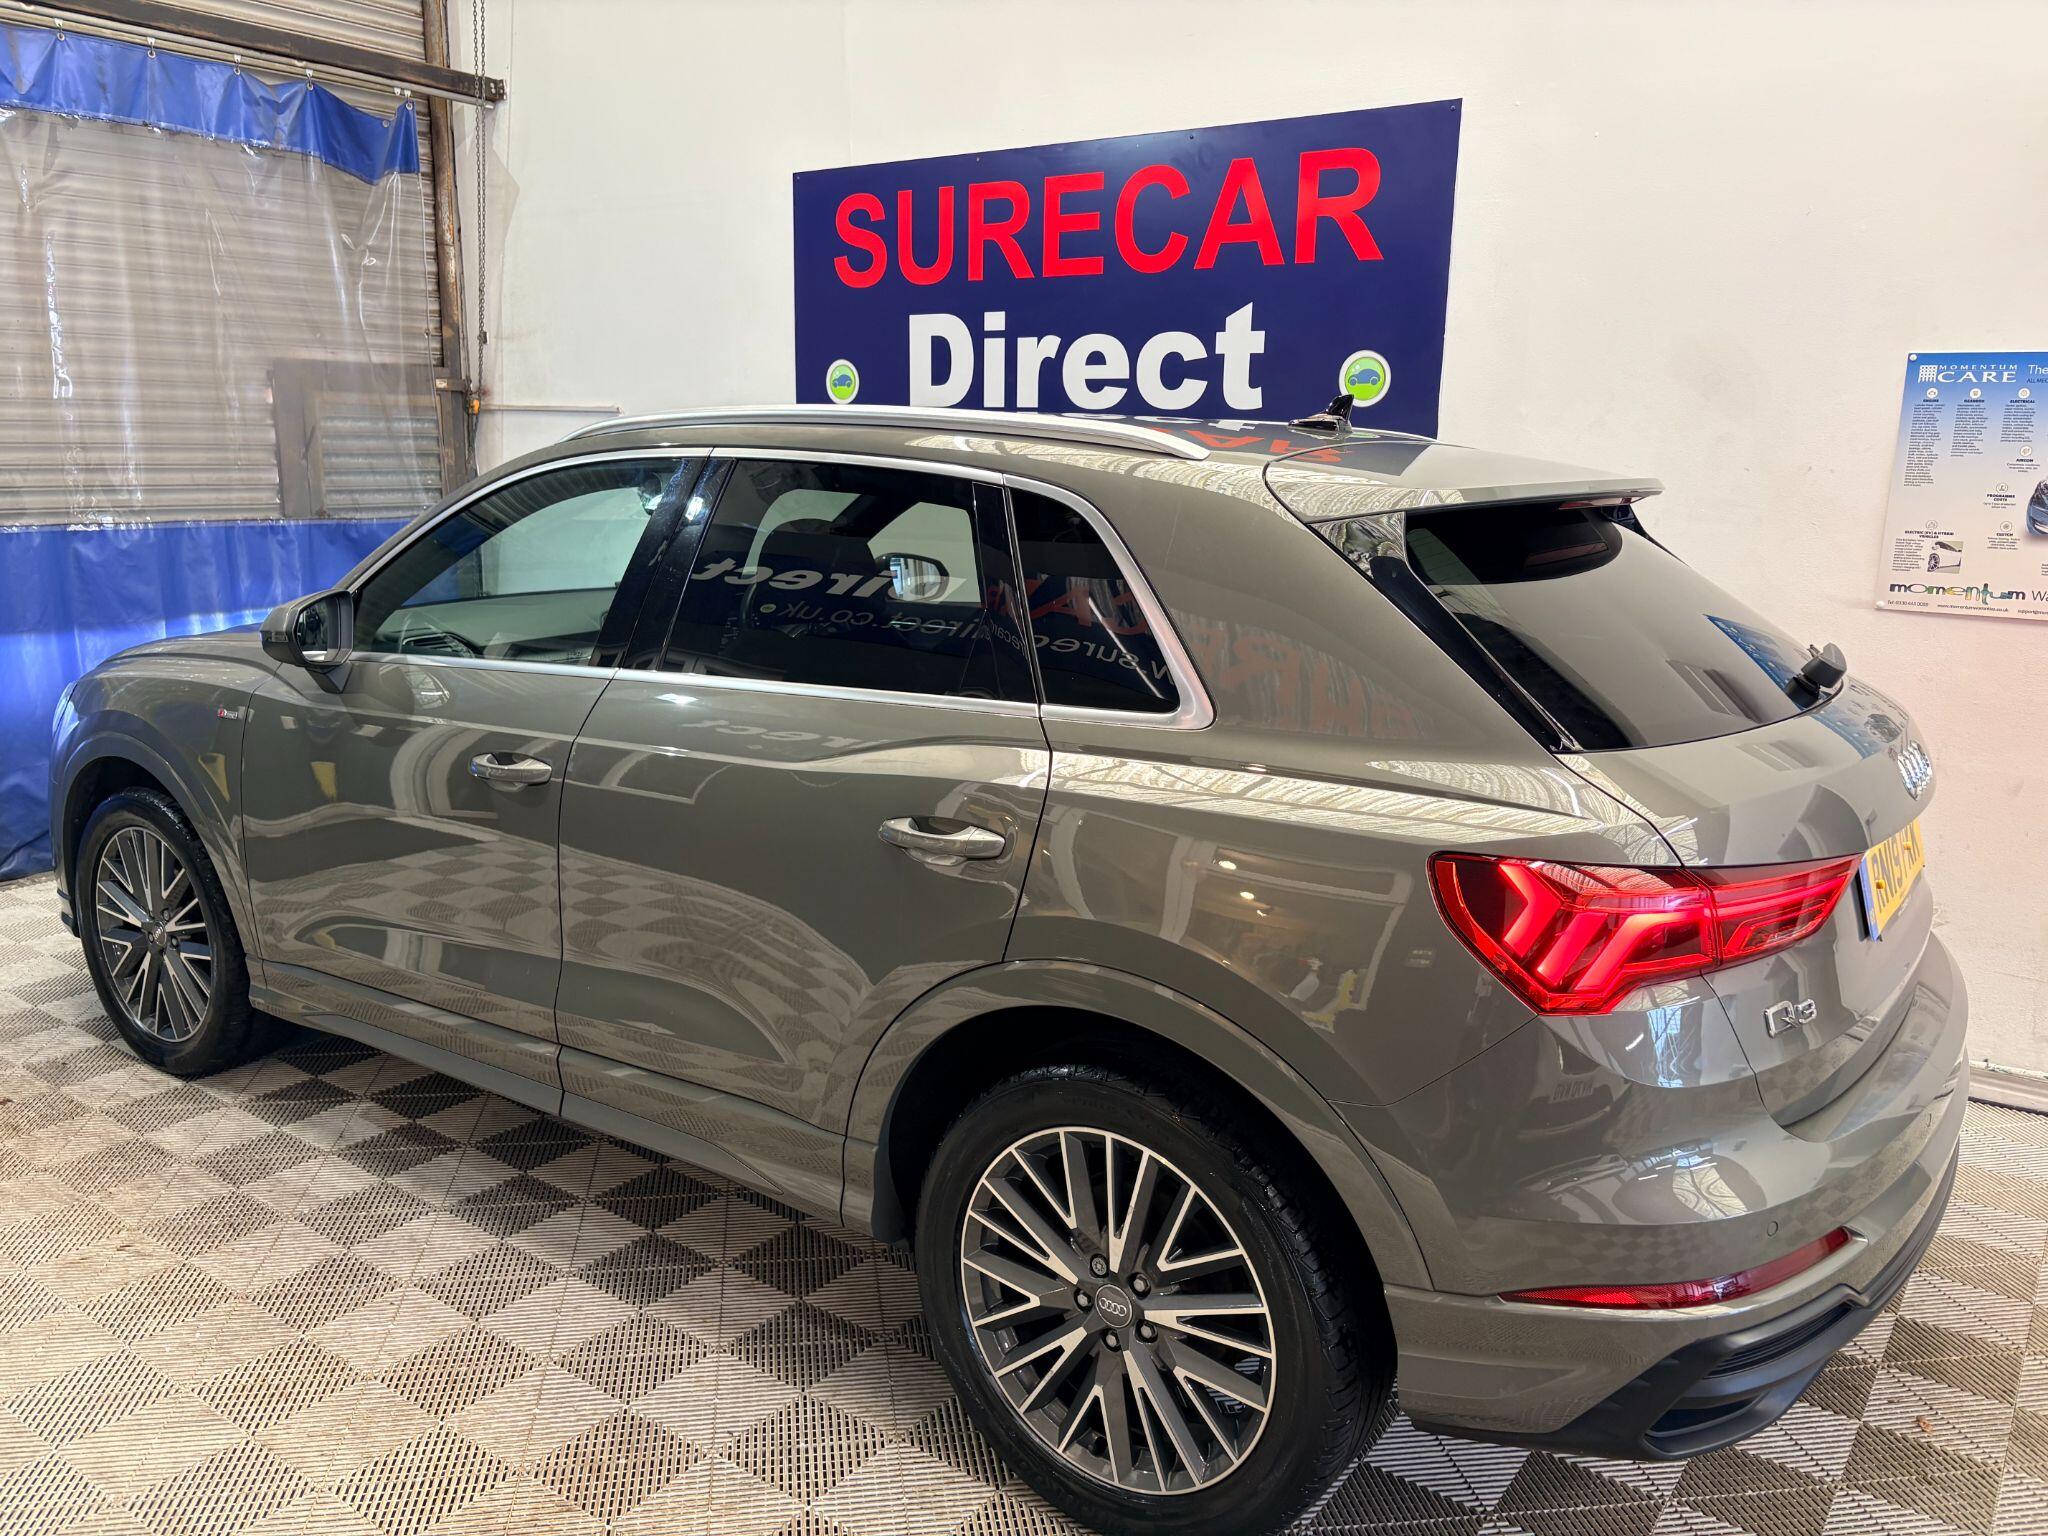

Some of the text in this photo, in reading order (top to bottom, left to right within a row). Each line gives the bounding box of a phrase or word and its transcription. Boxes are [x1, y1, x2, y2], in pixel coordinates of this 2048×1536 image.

[833, 147, 1384, 289] SURECAR
[908, 301, 1266, 408] Direct
[2028, 364, 2048, 375] The
[1937, 371, 2017, 383] CARE
[1889, 583, 2026, 605] momentum
[1763, 998, 1818, 1039] Q3
